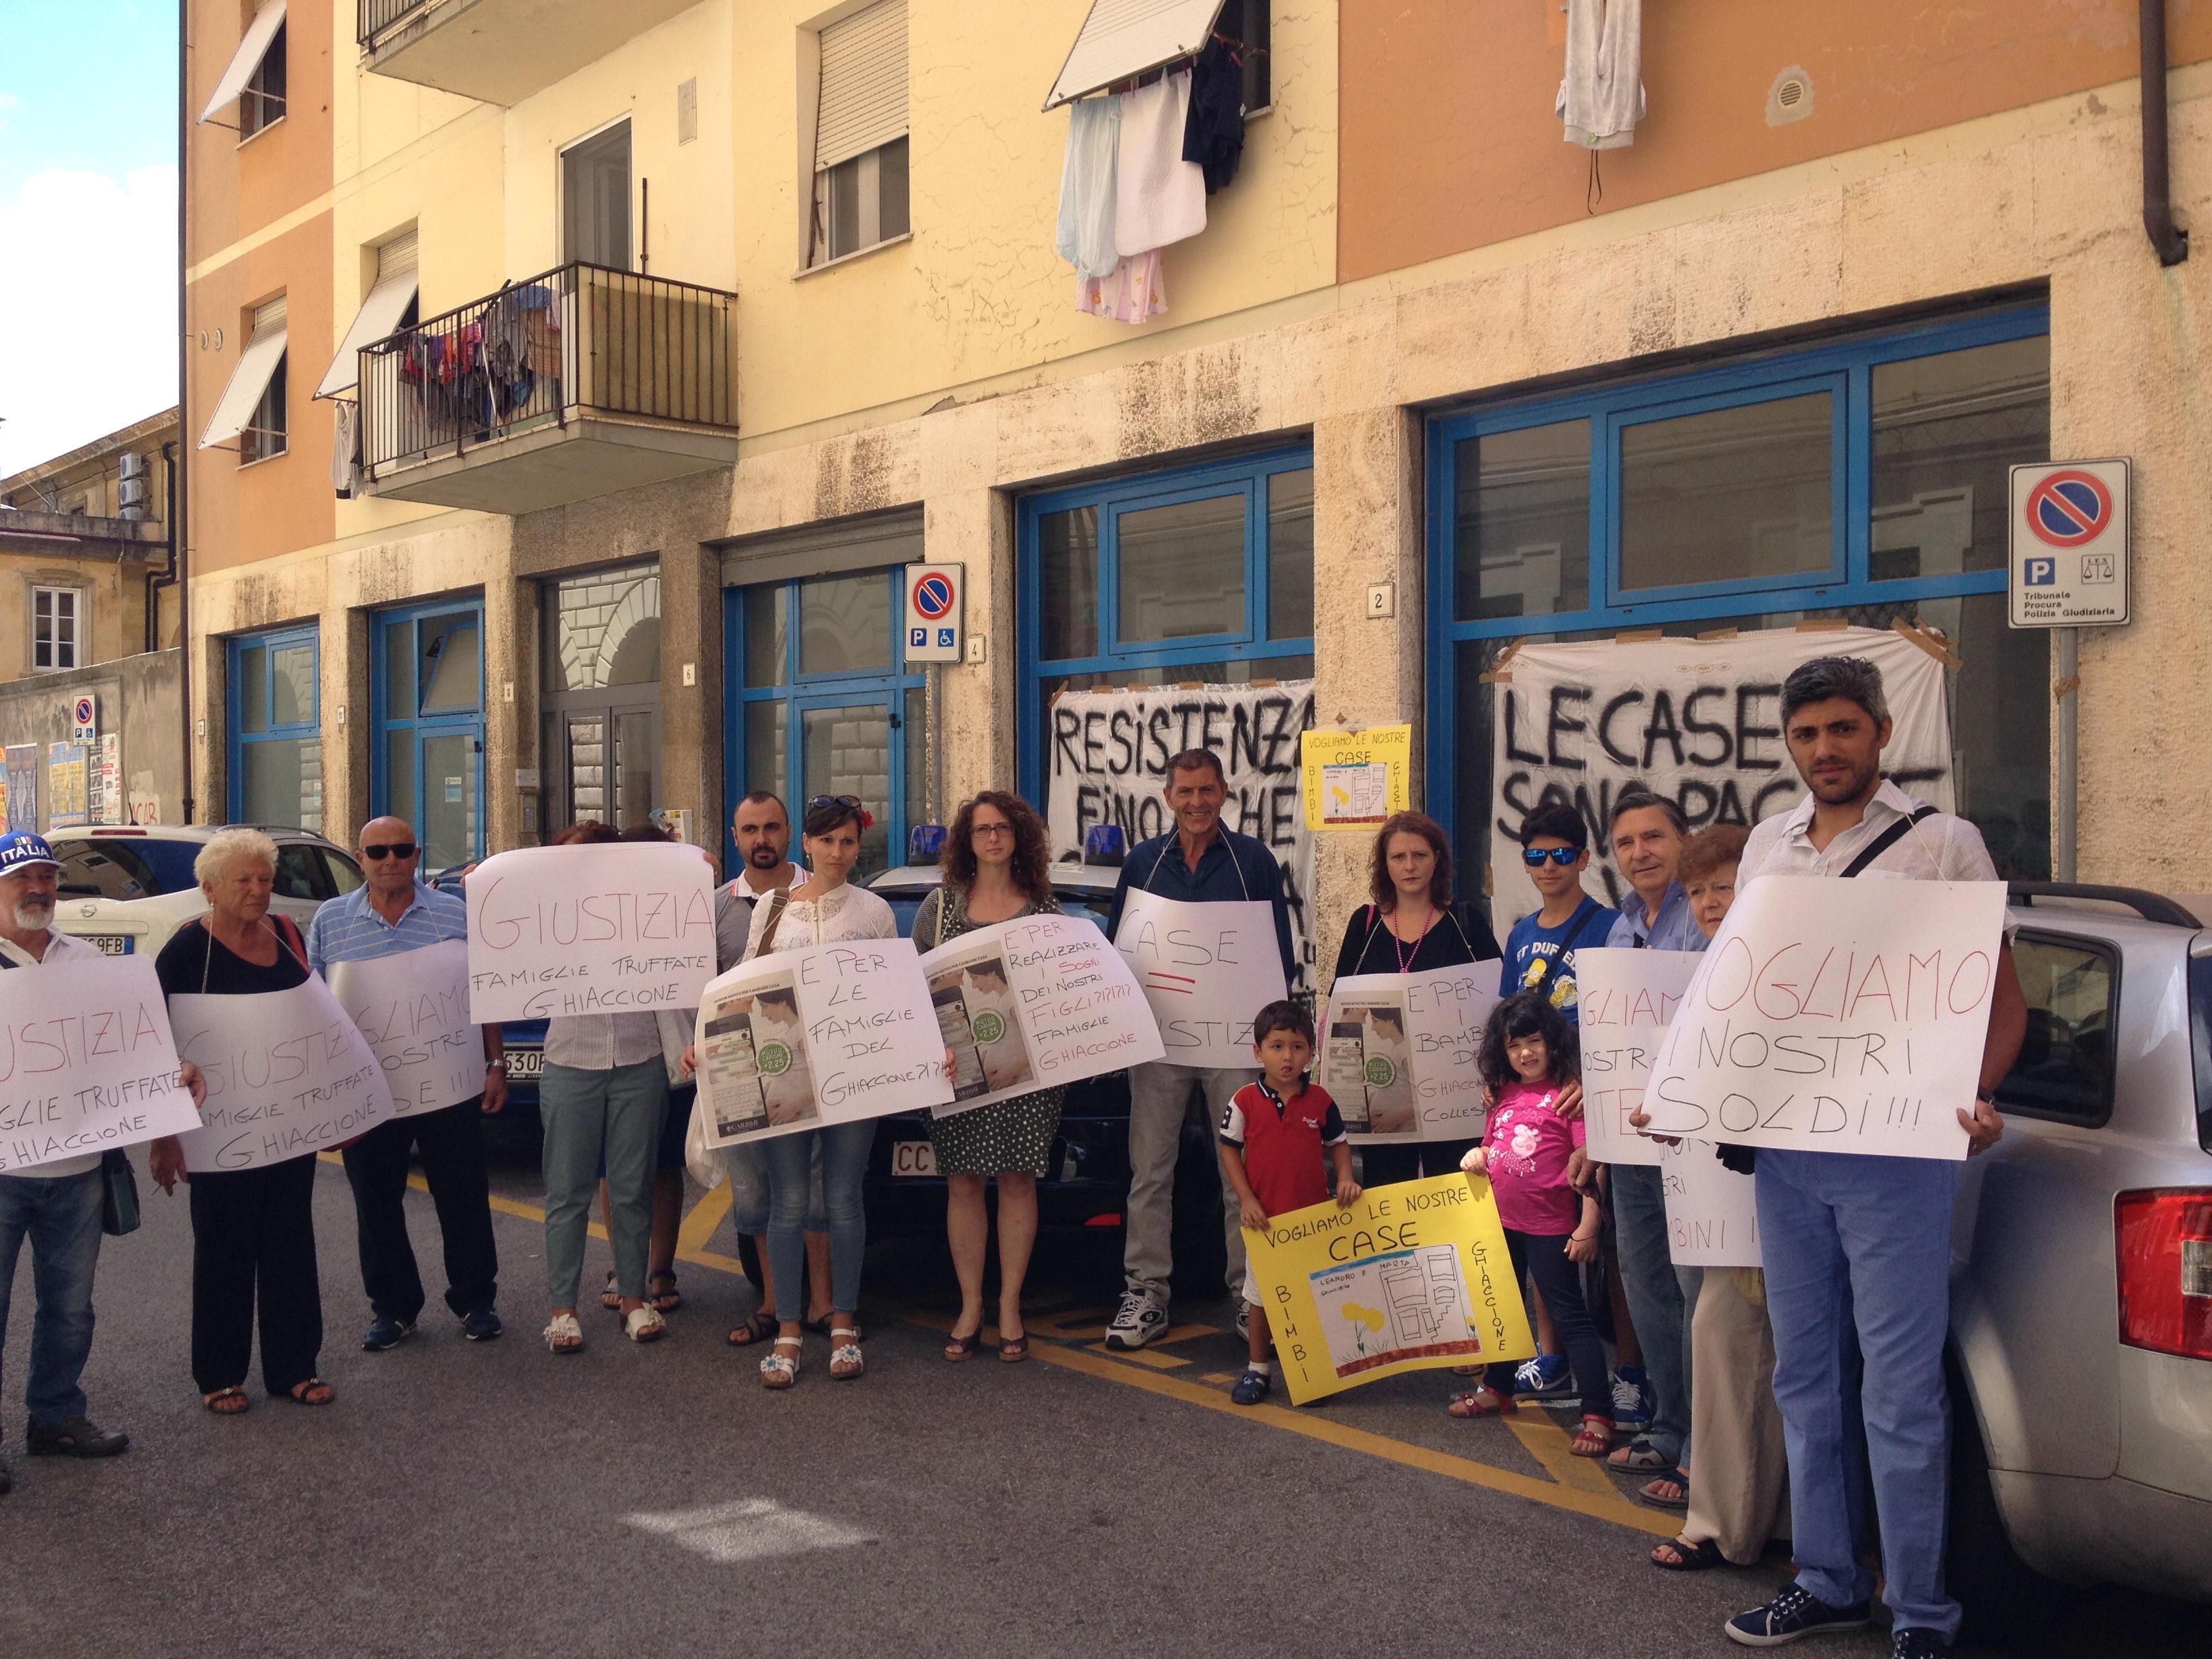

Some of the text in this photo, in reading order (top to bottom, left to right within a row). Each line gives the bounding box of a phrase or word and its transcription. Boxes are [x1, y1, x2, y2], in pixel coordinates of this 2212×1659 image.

[2032, 561, 2050, 583] P
[1375, 593, 1382, 609] 2
[2024, 592, 2070, 600] Tribunale
[2024, 608, 2114, 618] Polizia Giudiziaria
[914, 630, 924, 644] P
[972, 644, 977, 656] 4
[1309, 732, 1406, 748] VOGLIAMO LE NOSTRE
[1505, 682, 1782, 770] LE CASE
[1335, 751, 1371, 764] CASE
[1, 844, 49, 863] ITALIA
[479, 877, 715, 949] GIUSTIZIA
[1004, 922, 1065, 949] E PER
[1118, 909, 1238, 966] CASE
[802, 949, 888, 985] E PER
[1009, 941, 1101, 970] REALIZZARE
[1059, 958, 1101, 974] SOGNI
[472, 956, 708, 991] FAMIGLIE TRUFFATE
[1021, 973, 1103, 1003] DEI NOSTRI
[524, 983, 679, 1019] GHIACCIONE
[828, 984, 867, 1006] LE
[1408, 977, 1483, 1012] E PER
[1578, 988, 1684, 1028] GLIAM
[808, 1009, 914, 1044] FAMIGLIE
[1033, 1016, 1109, 1045] FAMIGLIE
[1158, 1019, 1254, 1047] STIZ
[374, 1030, 467, 1070] OSTRE
[842, 1036, 894, 1059] DEL
[1039, 1033, 1137, 1070] GHIACCIONE
[1698, 1019, 1912, 1078] NOSTRI
[74, 1069, 184, 1114] TRUFFATE
[293, 1065, 374, 1110] TRUFFATE
[0, 1115, 147, 1170] HIACCIONE
[216, 1094, 377, 1169] GHIACCIONE
[897, 1145, 930, 1172] CC
[1264, 1187, 1468, 1249] VOGLIAMO LE NOSTRE
[1329, 1221, 1420, 1262] CASE
[1320, 1273, 1355, 1286] LEANDRO
[1380, 1260, 1410, 1269] MARTA
[1472, 1242, 1506, 1351] GHIACCIONE
